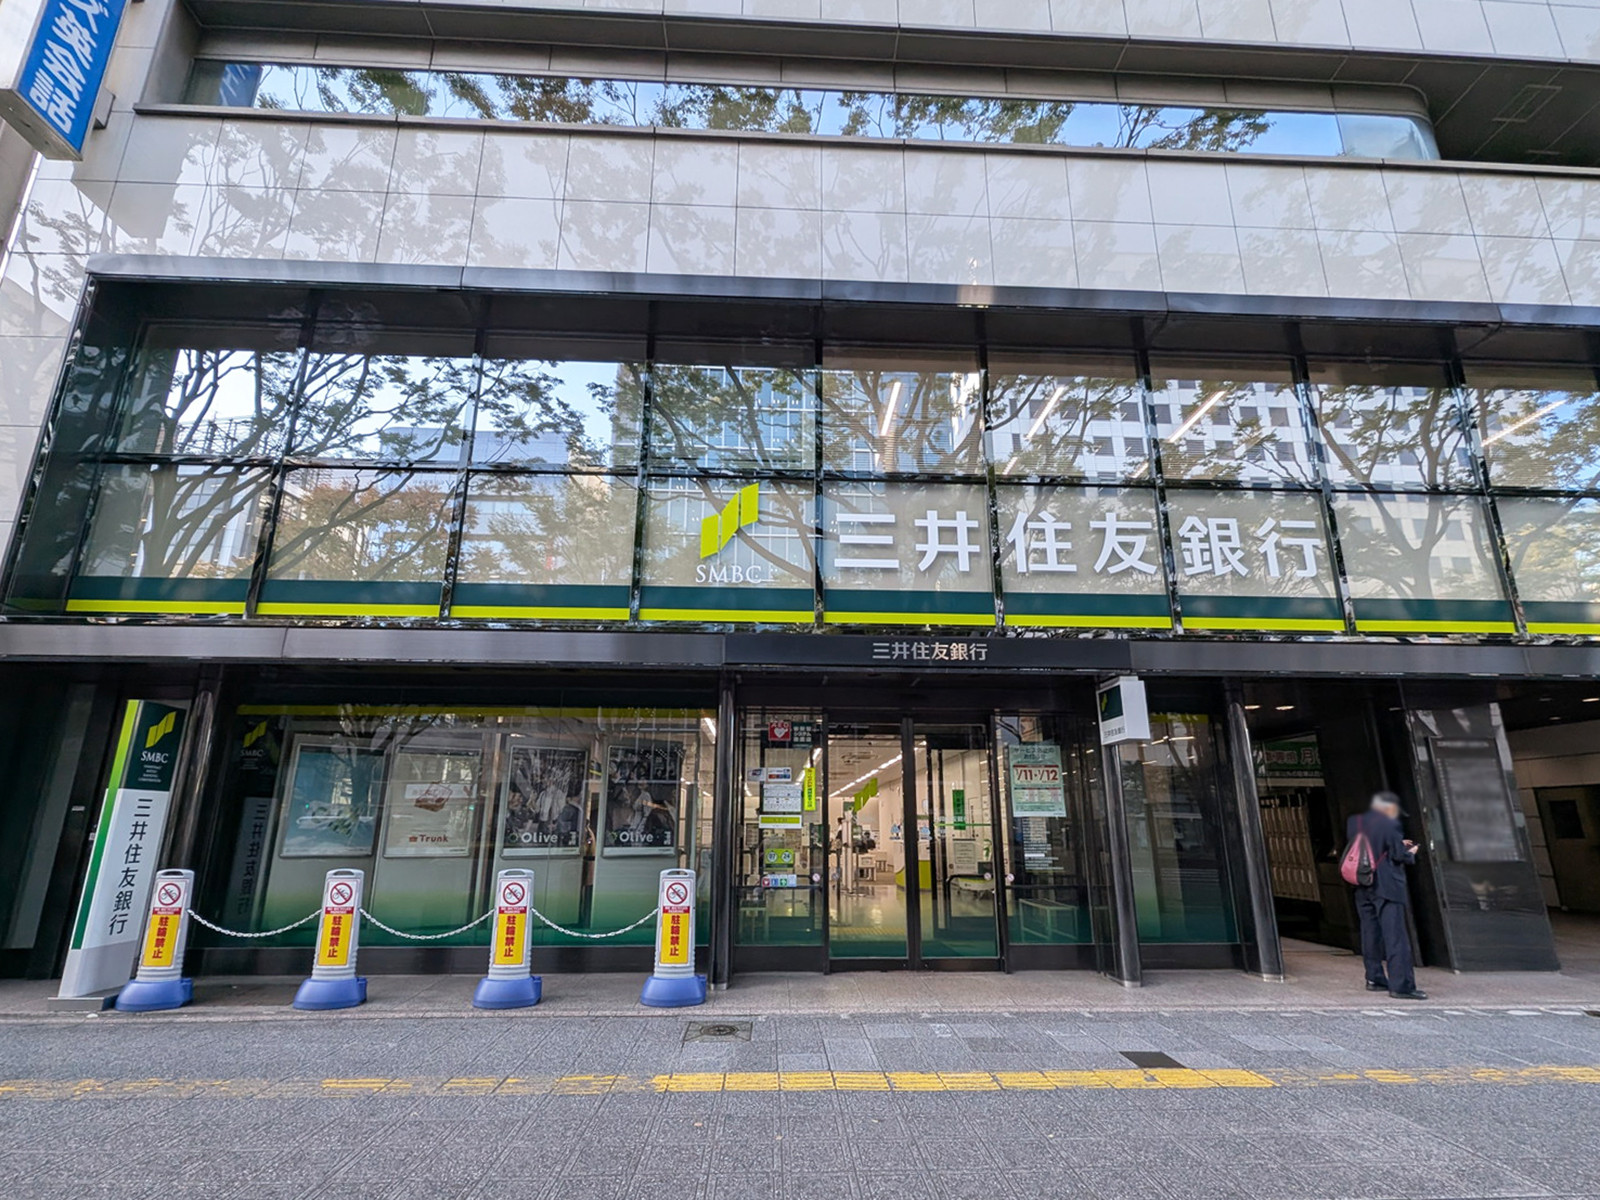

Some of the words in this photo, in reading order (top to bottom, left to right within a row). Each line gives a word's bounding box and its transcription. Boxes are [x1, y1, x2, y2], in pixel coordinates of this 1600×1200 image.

[29, 0, 110, 134] ズ英会話
[834, 510, 1321, 578] 三井住友銀行
[695, 564, 762, 584] SMBC
[872, 642, 988, 661] 三井住友銀行
[140, 750, 169, 763] SMBC
[419, 834, 449, 843] Trunk
[521, 832, 558, 843] Olive
[619, 831, 654, 843] Olive
[108, 798, 153, 936] 三井住友銀行
[152, 916, 169, 959] 駐輪禁止
[327, 915, 343, 958] 駐輪禁止
[503, 915, 517, 957] 駐輪禁止
[669, 914, 681, 957] 駐輪禁止
